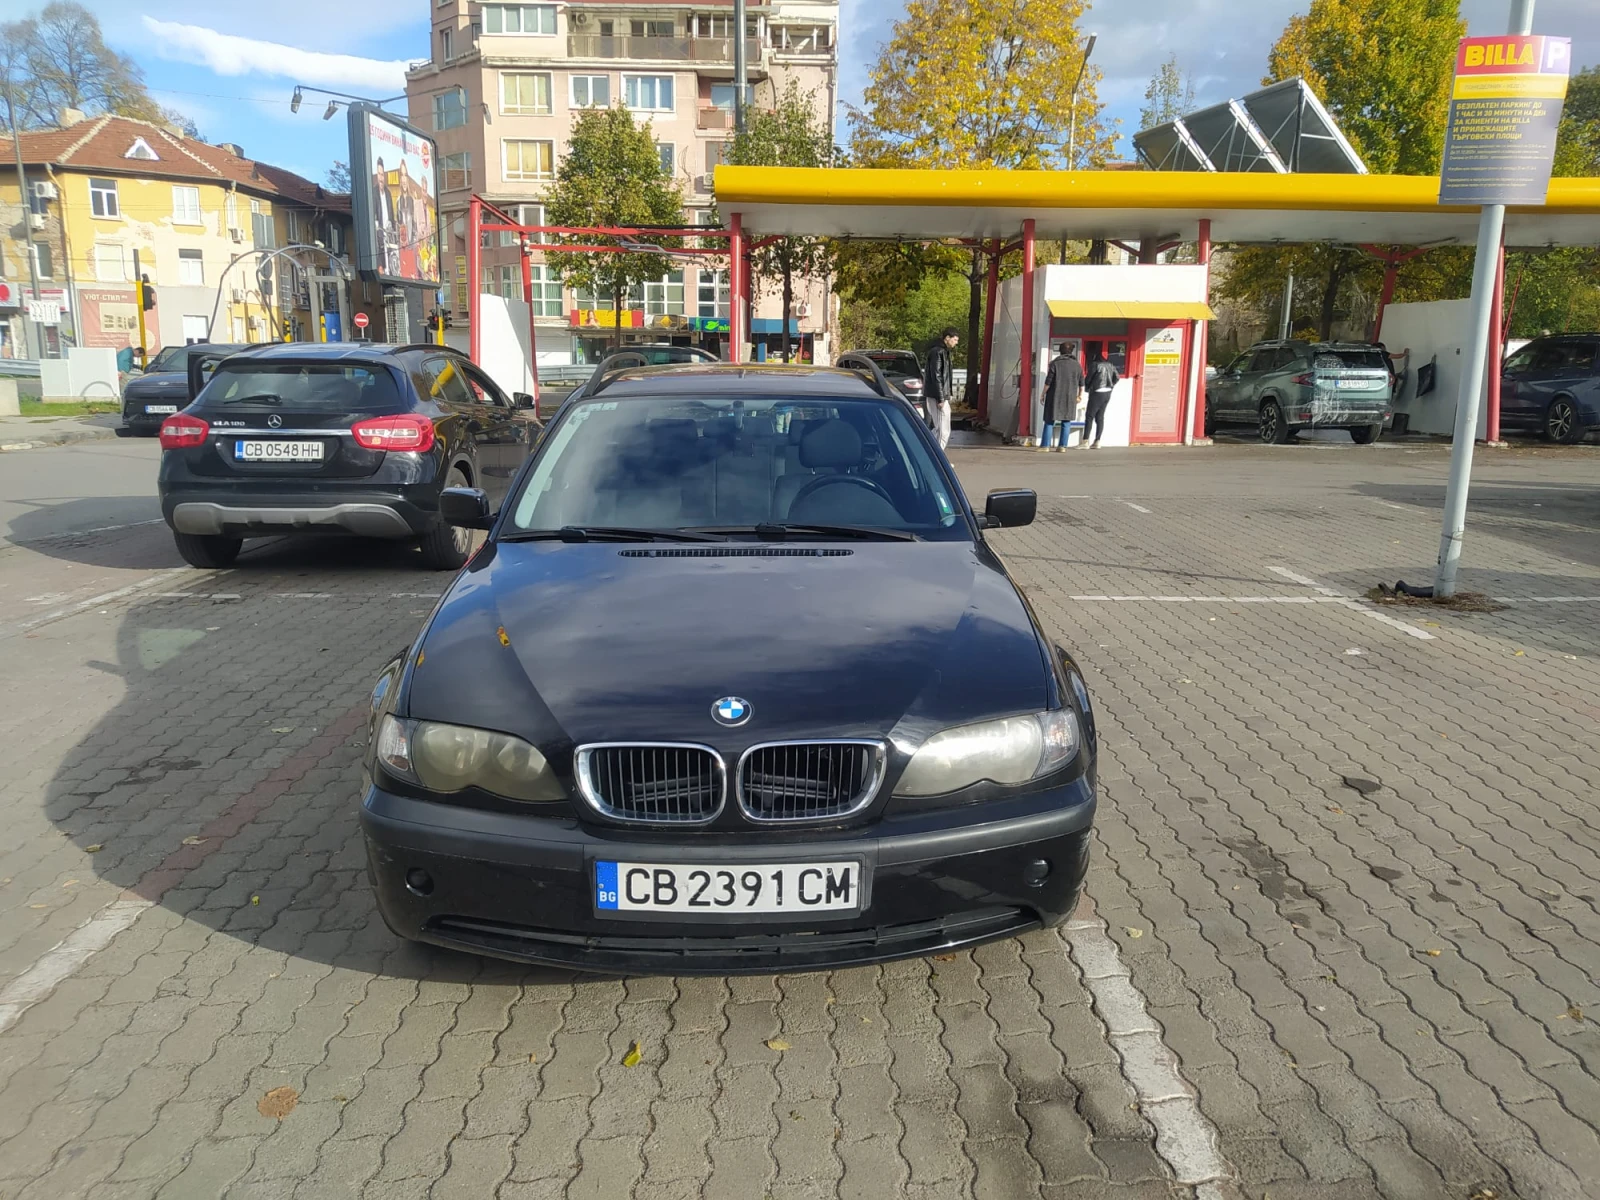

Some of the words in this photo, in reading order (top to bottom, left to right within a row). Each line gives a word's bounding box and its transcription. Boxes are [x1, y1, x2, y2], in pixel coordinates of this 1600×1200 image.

[1464, 44, 1535, 67] BILLA
[1456, 102, 1499, 110] БЕЗПЛАТЕН
[1500, 101, 1532, 109] ПАРКИНГ
[1532, 101, 1543, 109] ДО
[1493, 109, 1523, 117] МИНУТИ
[1532, 109, 1547, 117] ДЕН
[1460, 125, 1517, 133] ПРИЛЕЖАЩИТЕ
[1452, 133, 1495, 141] ТЪРГОВСКИ
[1495, 132, 1523, 140] ПЛОЩИ
[245, 443, 263, 457] CB
[266, 443, 299, 457] 0548
[301, 443, 320, 457] HH
[599, 890, 617, 903] BG
[625, 867, 678, 905] CB
[688, 868, 783, 907] 2391
[798, 866, 851, 905] CM
